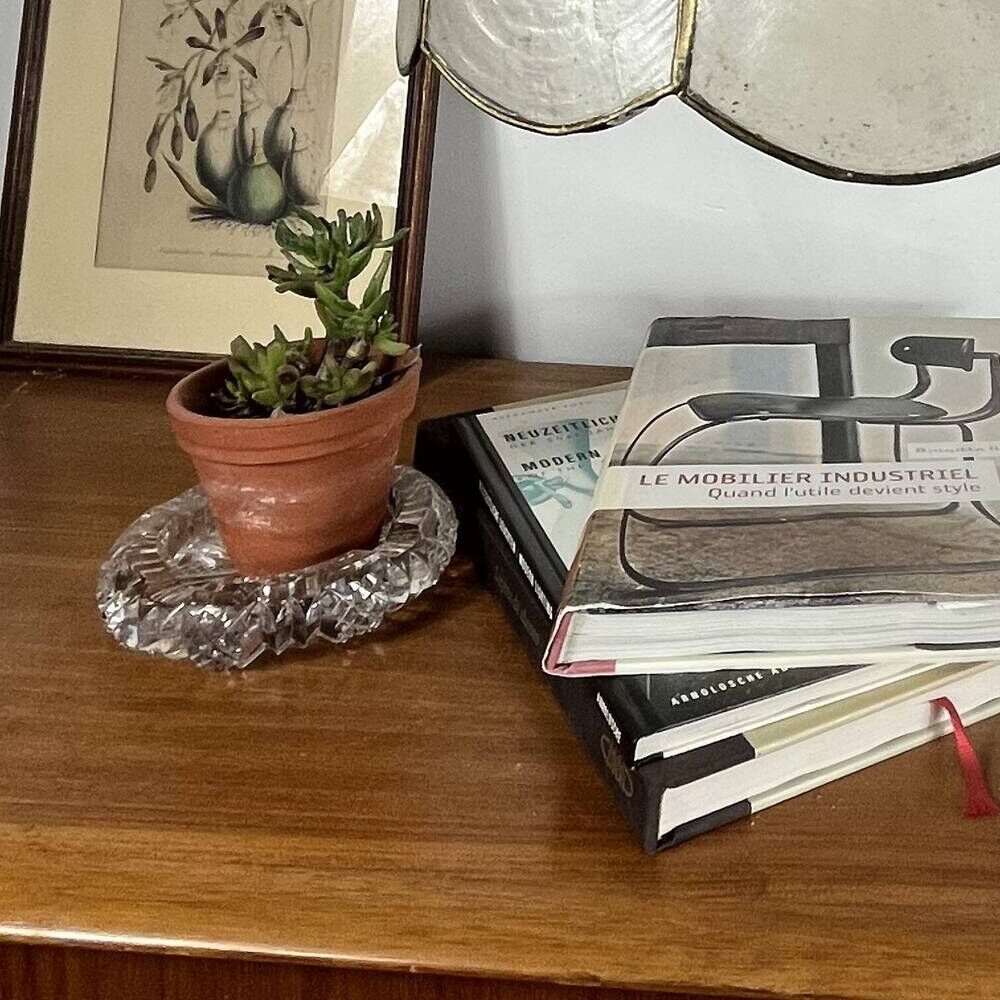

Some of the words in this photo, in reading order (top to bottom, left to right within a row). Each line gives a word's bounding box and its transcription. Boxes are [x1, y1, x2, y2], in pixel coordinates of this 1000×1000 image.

[520, 449, 602, 472] MODERN
[639, 473, 669, 486] LE
[677, 472, 812, 485] MOBILIER
[820, 468, 979, 484] INDUSTRIEL
[708, 486, 777, 500] Quand
[783, 486, 841, 498] l'utile
[848, 484, 926, 496] devient
[932, 482, 982, 496] style
